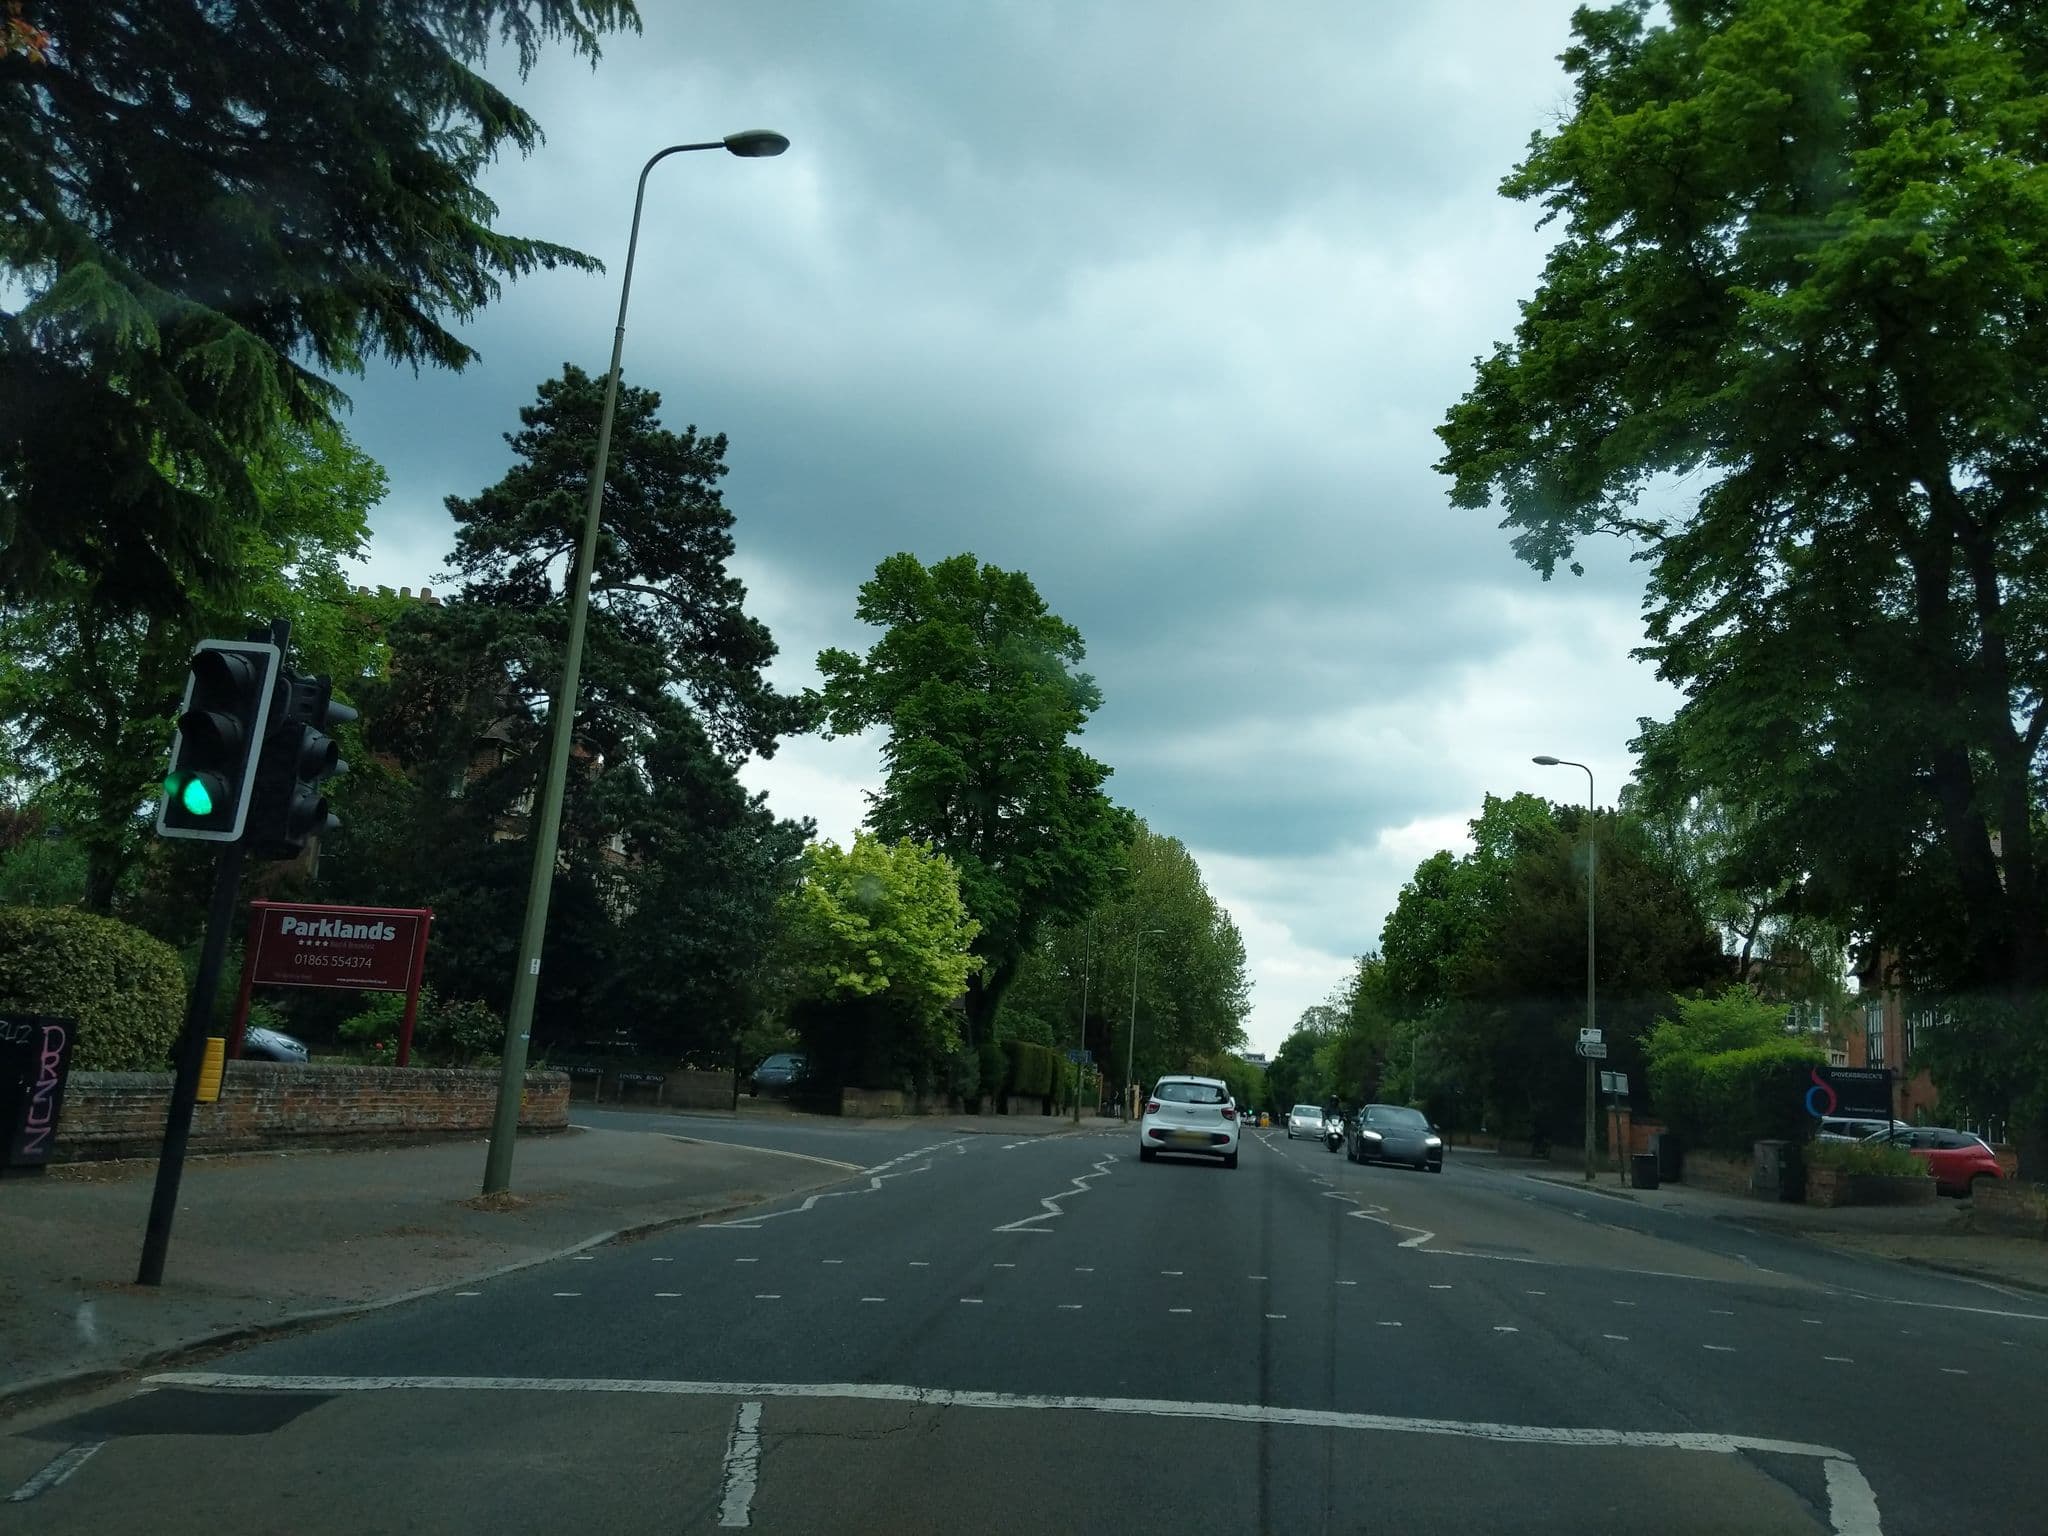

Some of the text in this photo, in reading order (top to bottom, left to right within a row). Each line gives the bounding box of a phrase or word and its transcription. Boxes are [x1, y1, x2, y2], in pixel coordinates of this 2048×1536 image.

[281, 916, 396, 941] Parklands
[294, 953, 372, 969] 01865 554374
